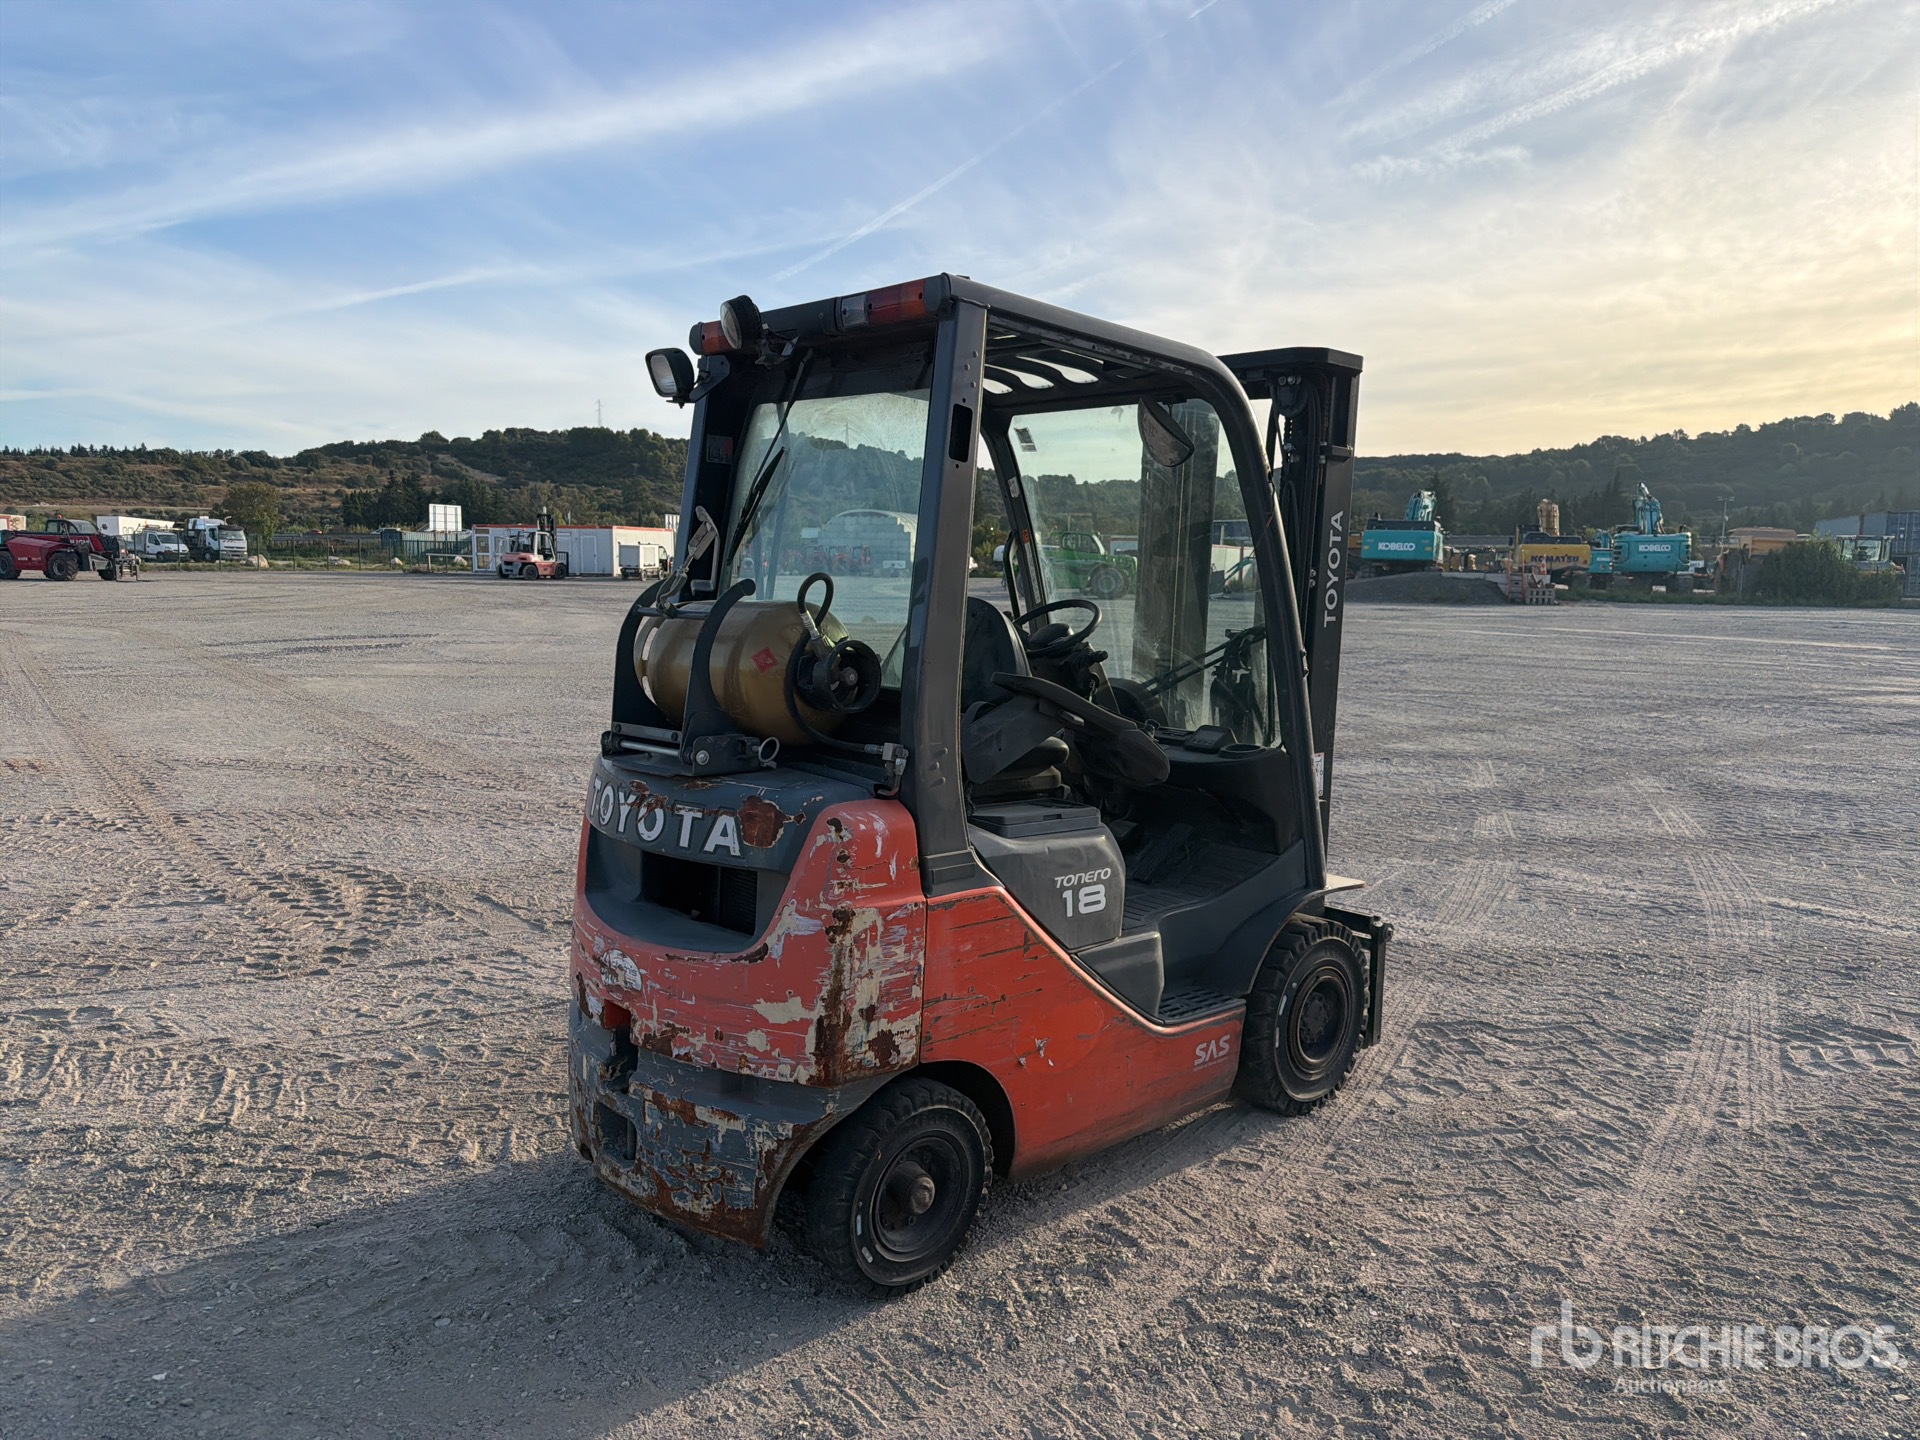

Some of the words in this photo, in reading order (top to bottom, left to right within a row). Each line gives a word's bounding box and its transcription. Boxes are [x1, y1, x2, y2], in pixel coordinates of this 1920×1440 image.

[1377, 542, 1416, 551] KOBELCO
[1638, 544, 1672, 552] KOBELCO
[1323, 510, 1344, 628] TOYOTA
[589, 778, 742, 857] TOYOTA
[1062, 884, 1106, 918] 18
[1193, 1034, 1231, 1066] SAS
